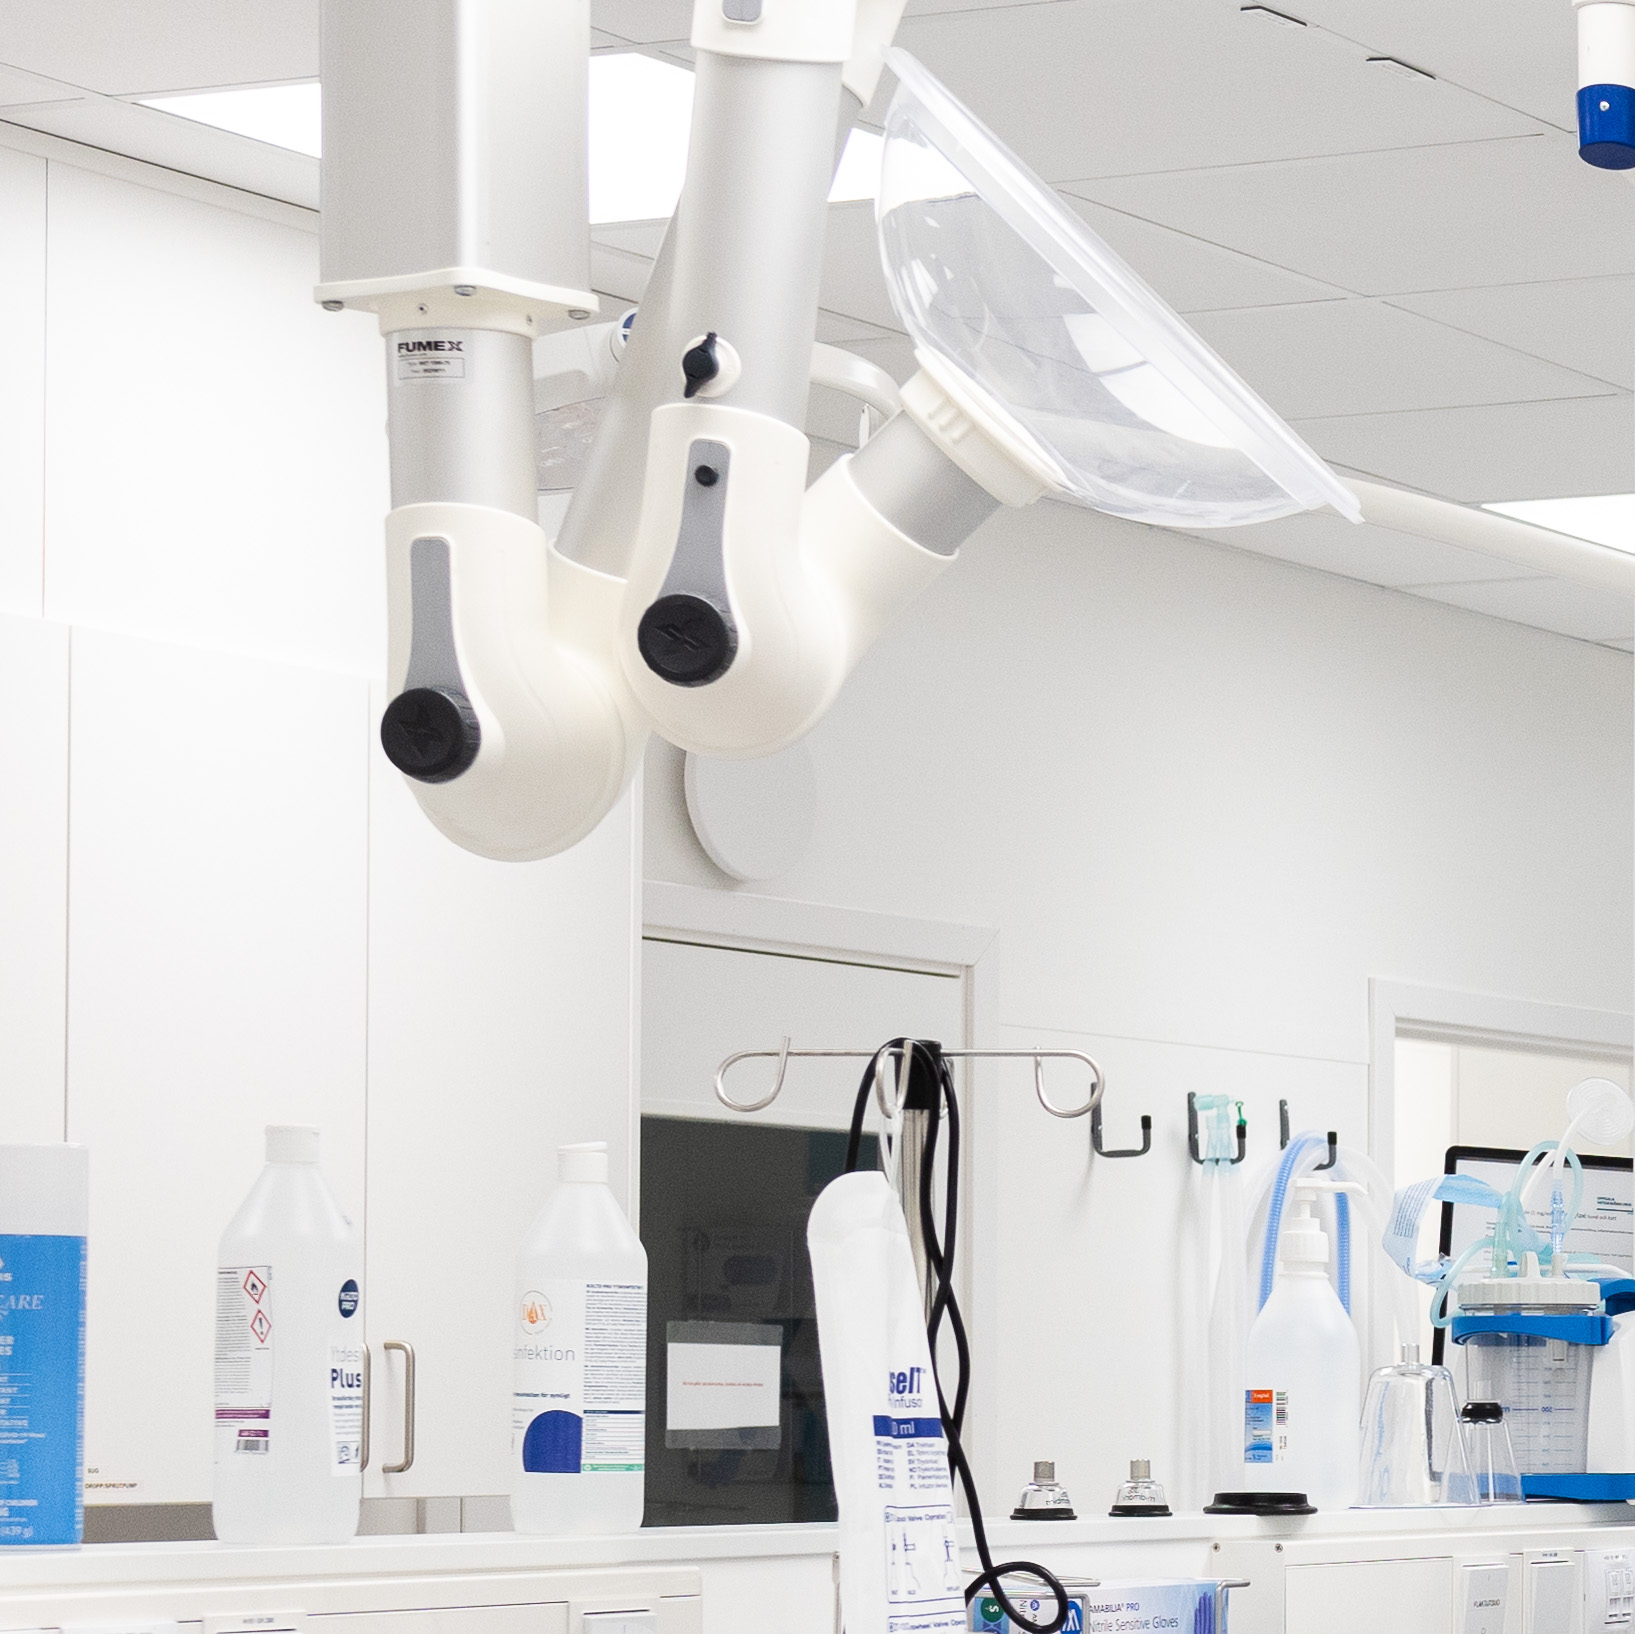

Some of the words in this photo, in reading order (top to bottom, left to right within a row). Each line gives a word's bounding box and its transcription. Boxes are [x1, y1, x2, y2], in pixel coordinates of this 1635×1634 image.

[397, 340, 464, 354] FUMEX
[330, 1368, 362, 1389] Plus
[900, 1421, 916, 1435] ml
[1126, 1602, 1140, 1612] PRO
[1115, 1618, 1151, 1632] Sensitive
[1152, 1615, 1179, 1629] Gloves
